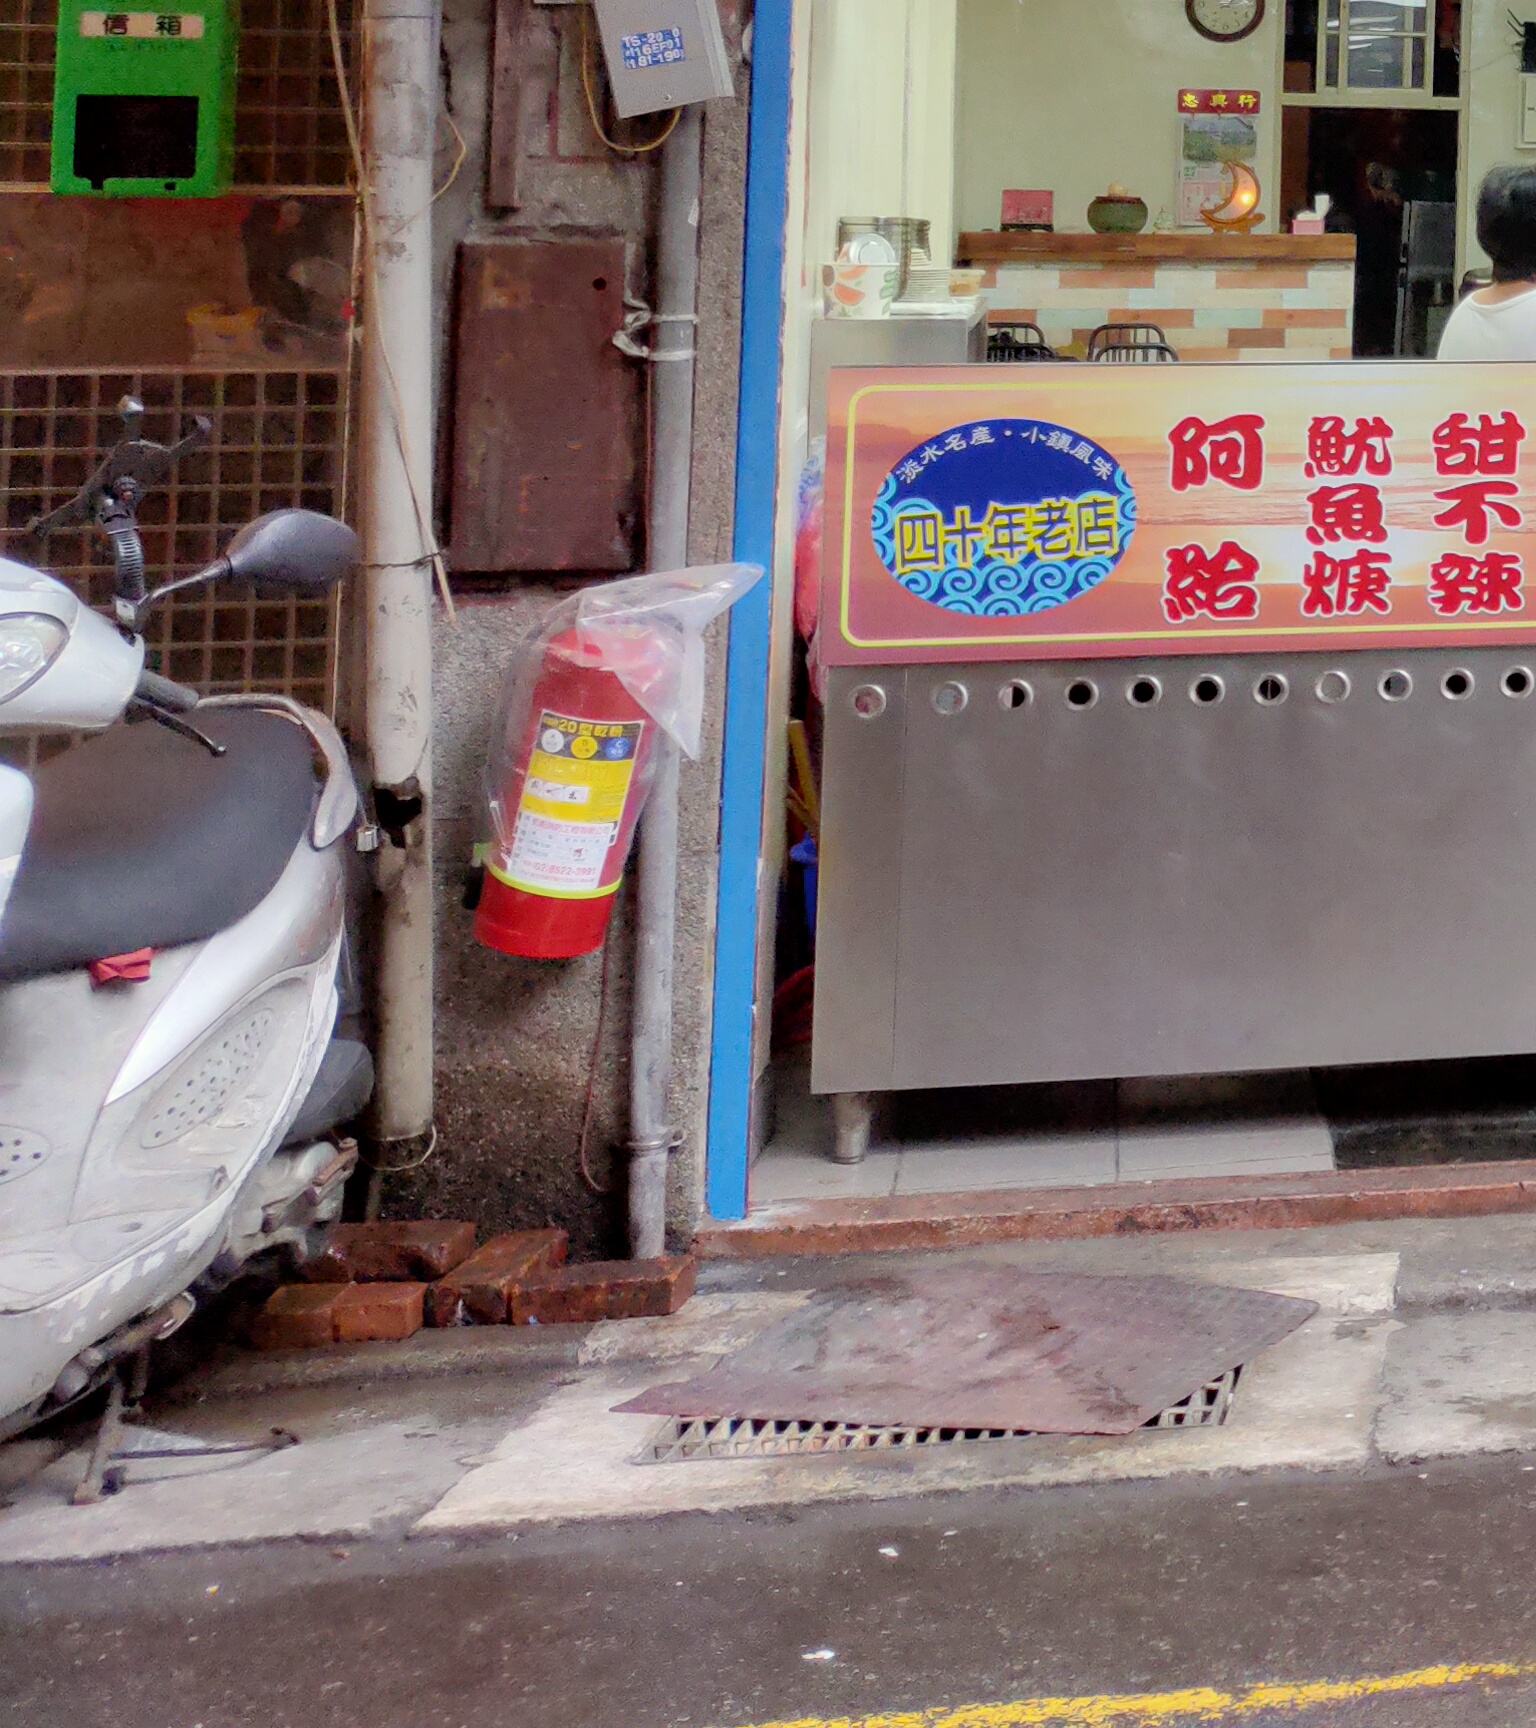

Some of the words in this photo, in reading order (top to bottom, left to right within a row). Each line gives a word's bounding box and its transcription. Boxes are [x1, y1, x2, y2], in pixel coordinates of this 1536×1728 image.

[896, 495, 1119, 574] 四十年老店
[1163, 413, 1265, 620] 阿給
[1427, 411, 1525, 615] 甜不辣
